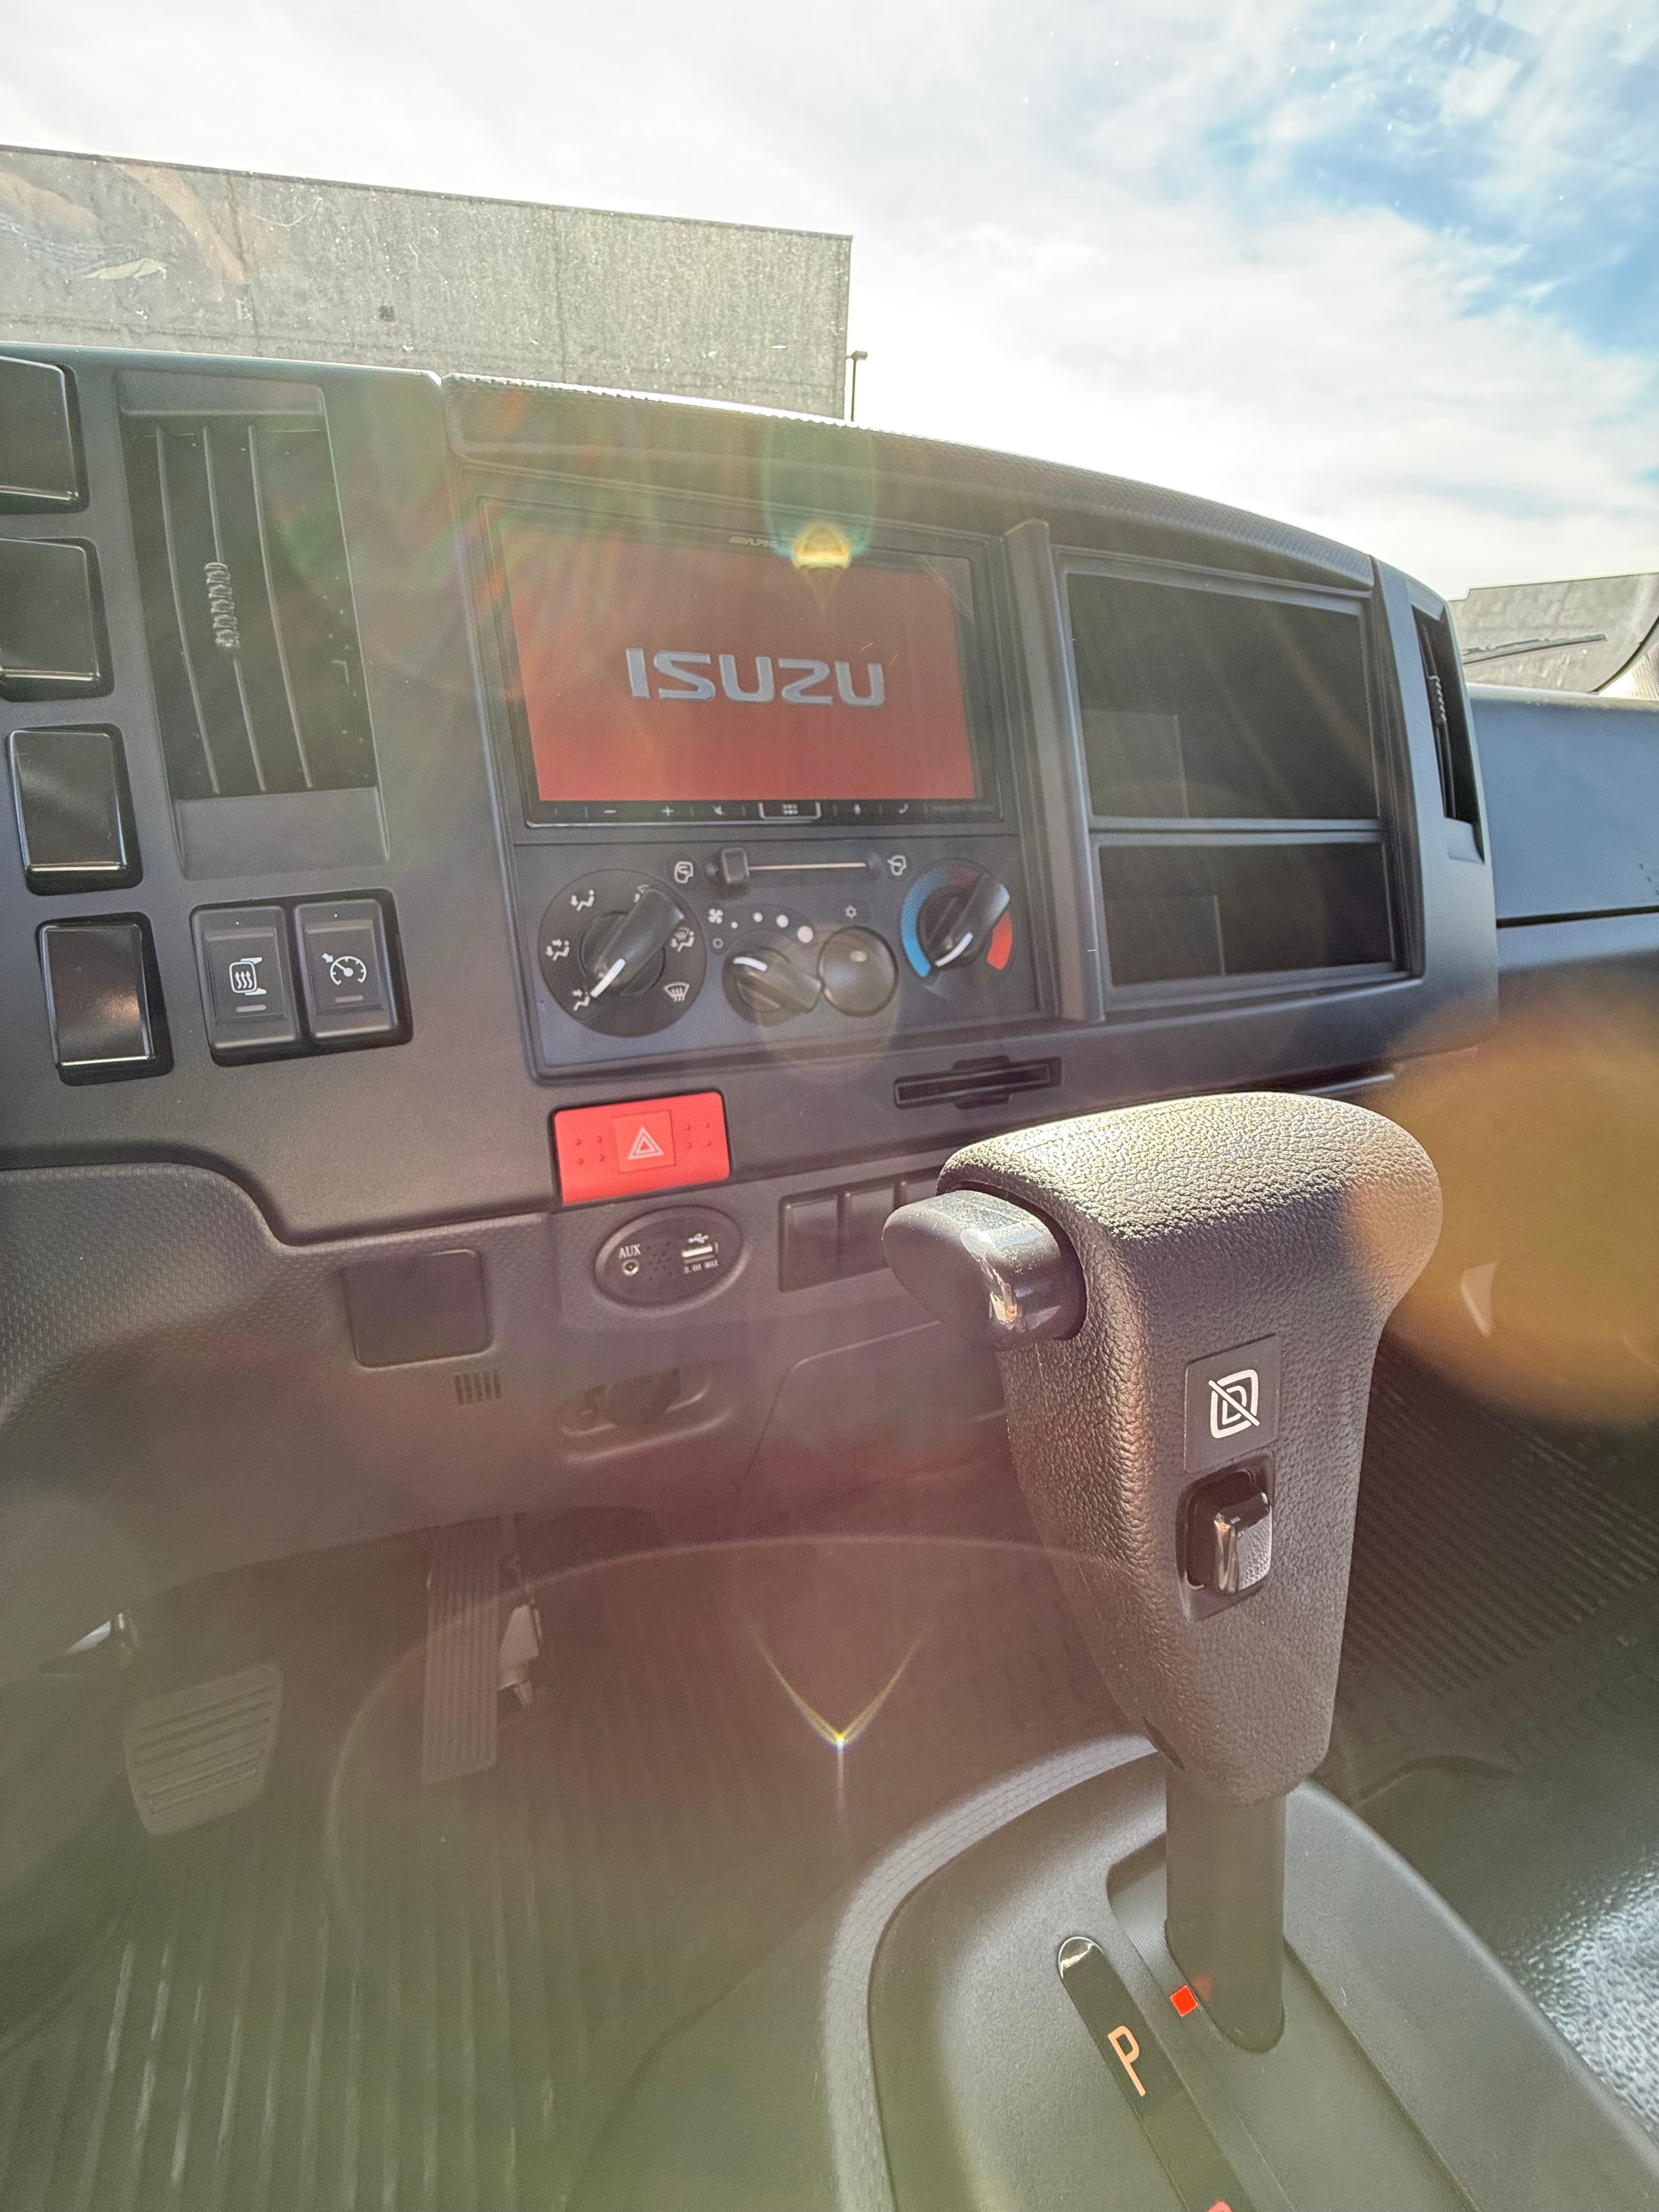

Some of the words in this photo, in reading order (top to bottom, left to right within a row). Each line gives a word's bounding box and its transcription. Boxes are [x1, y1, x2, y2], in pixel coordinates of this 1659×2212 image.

[626, 647, 885, 708] ISUZU
[618, 1243, 641, 1259] AUX
[704, 1259, 719, 1269] MAX
[1108, 2025, 1146, 2097] P
